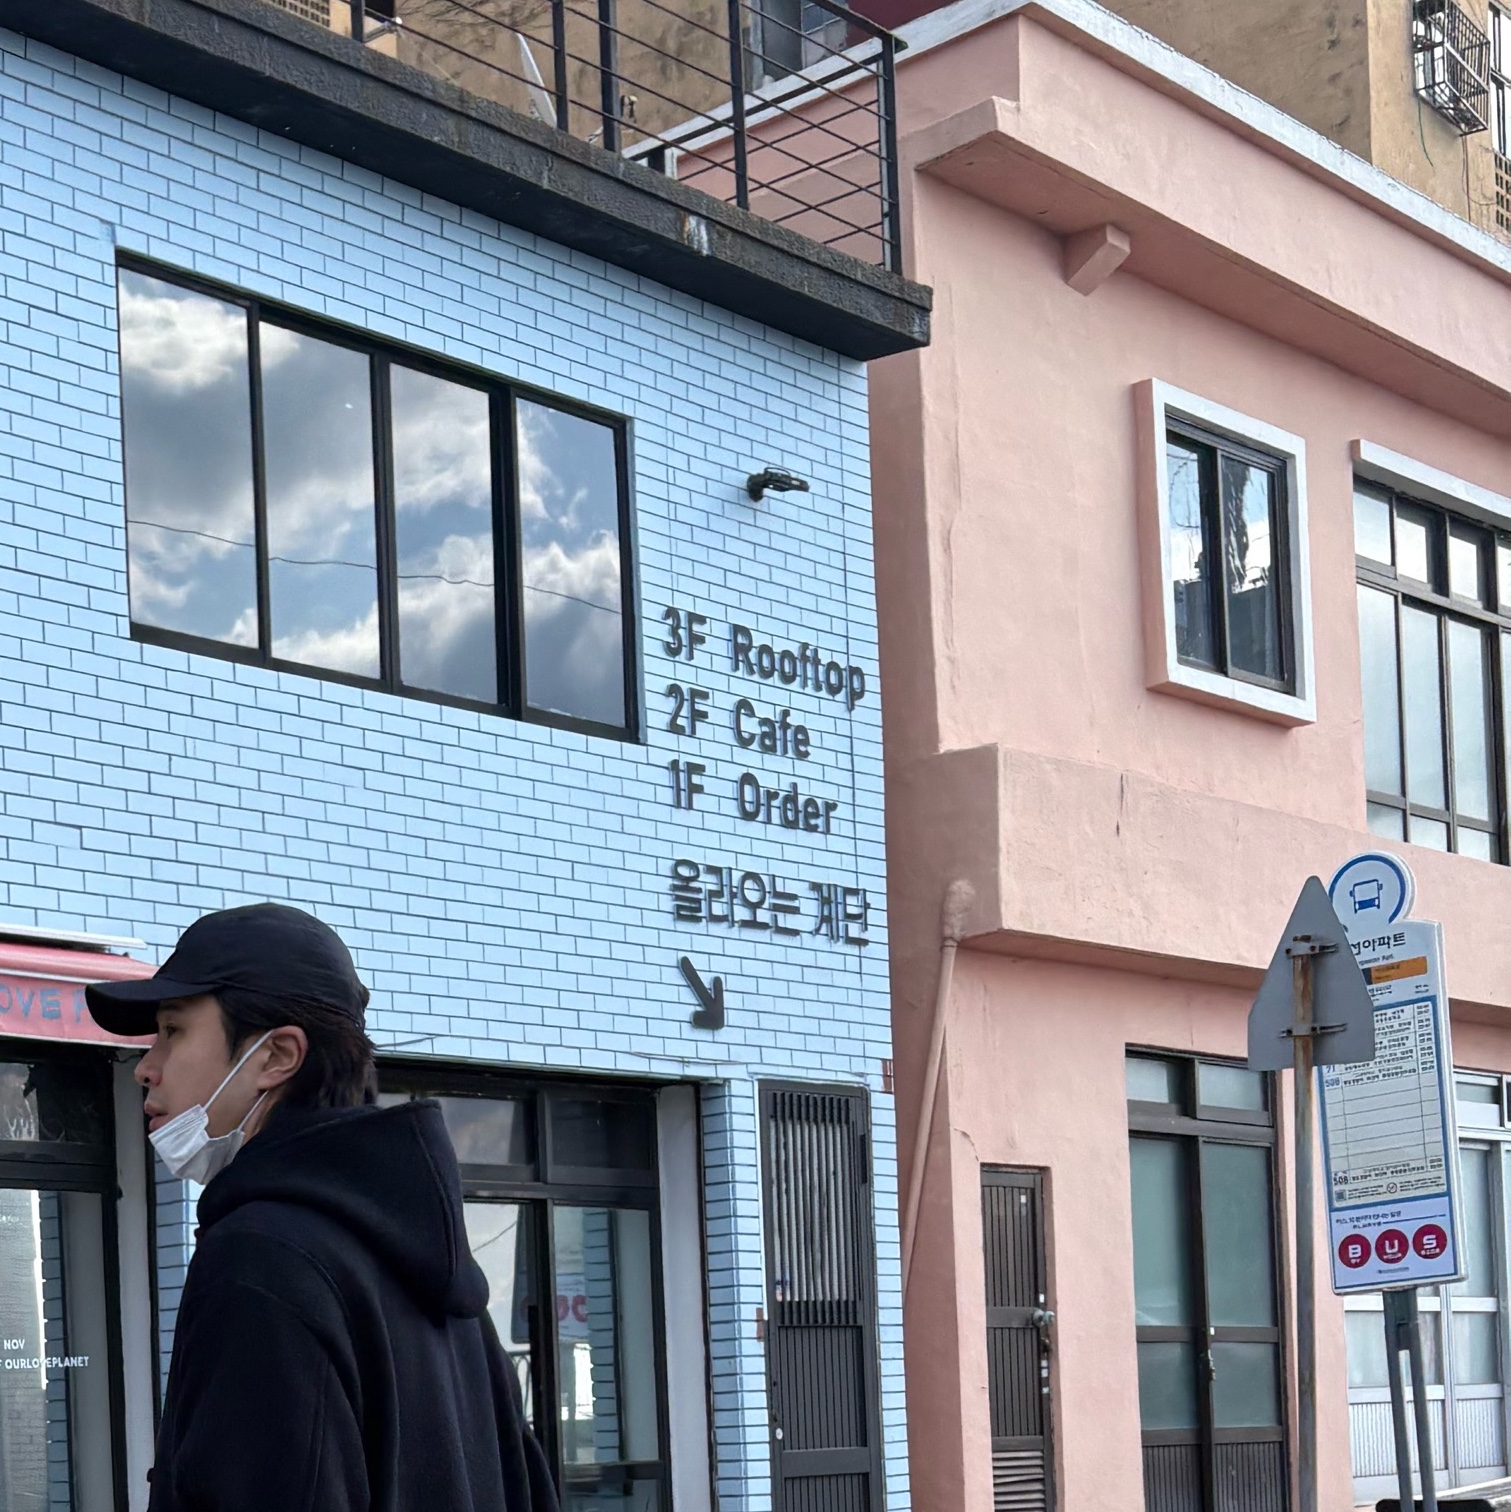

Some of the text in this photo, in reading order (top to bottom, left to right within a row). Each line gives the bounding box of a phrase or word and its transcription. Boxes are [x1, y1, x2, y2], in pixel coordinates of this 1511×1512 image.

[663, 606, 866, 712] 3F Rooftop
[666, 683, 811, 759] 2F Cafe
[670, 758, 838, 835] 1F Order
[3, 1338, 26, 1350] NOV
